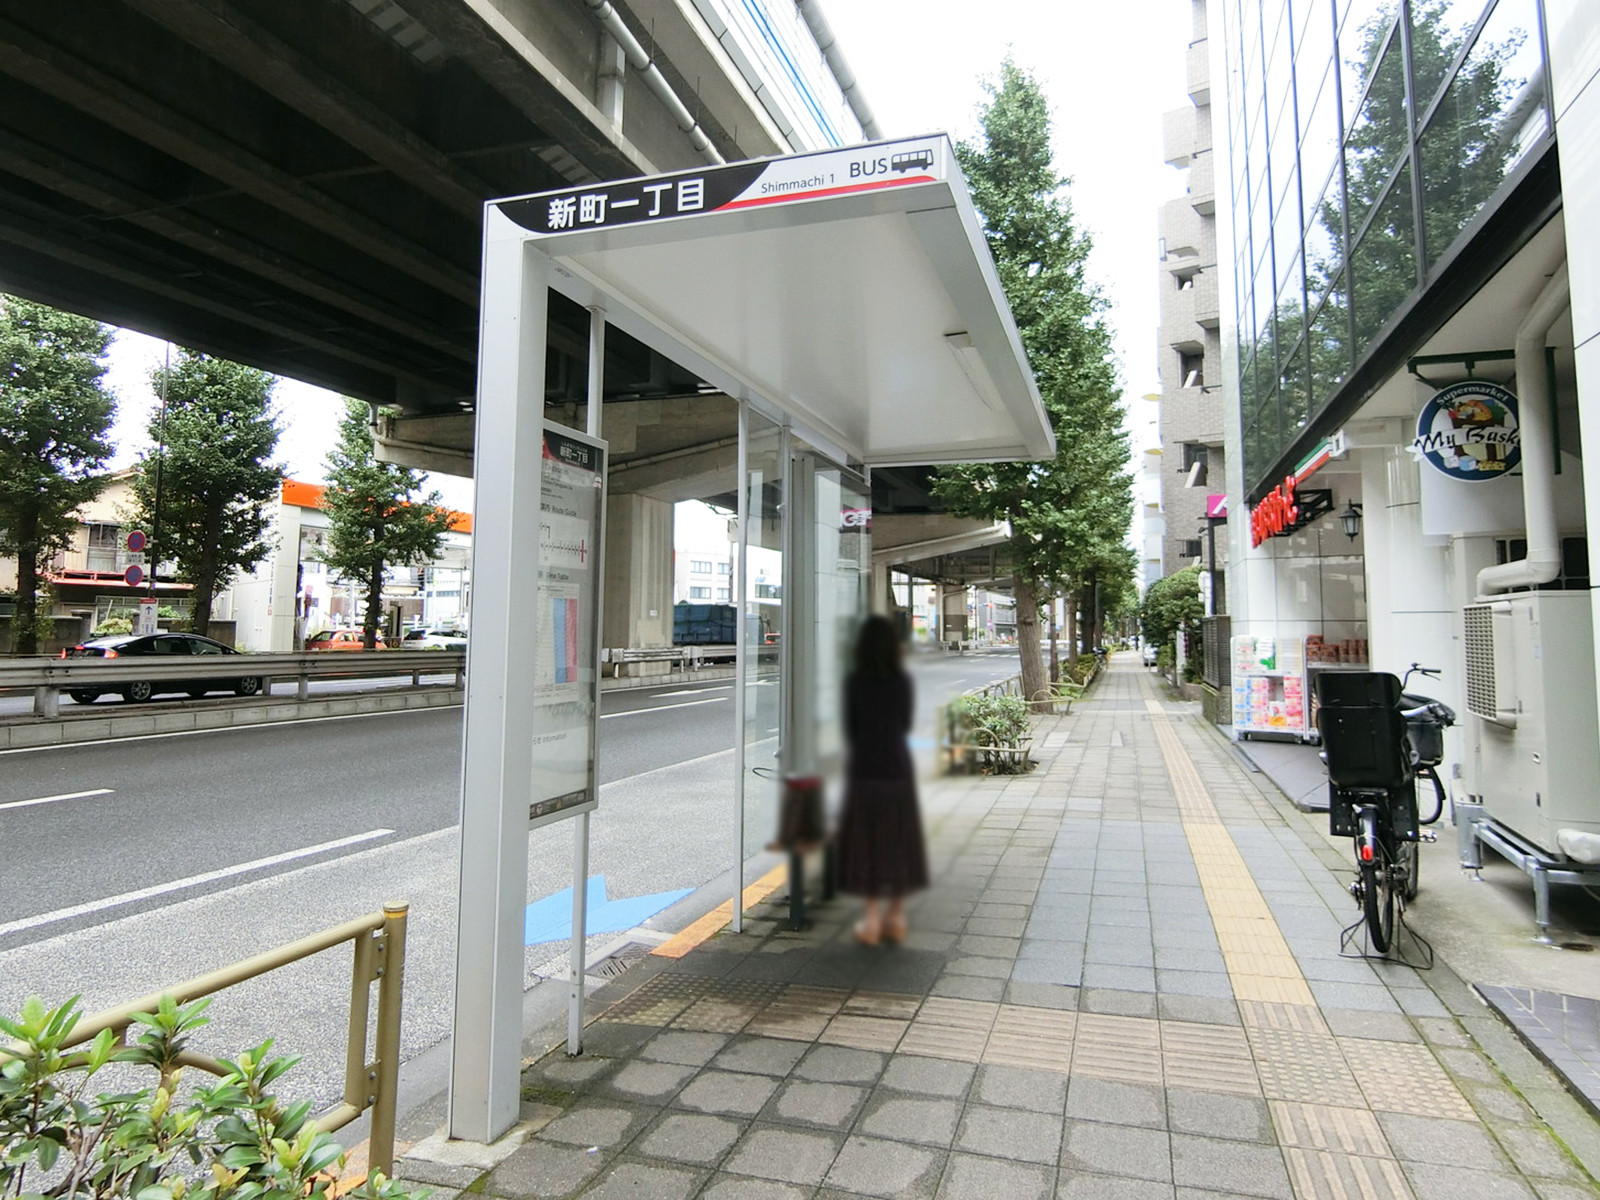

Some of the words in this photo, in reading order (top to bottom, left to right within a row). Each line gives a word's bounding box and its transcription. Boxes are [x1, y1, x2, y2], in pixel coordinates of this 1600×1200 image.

[850, 158, 888, 178] BUS
[761, 175, 825, 194] Shimmachi
[829, 173, 835, 184] 1
[548, 178, 705, 230] 新町一丁目
[1436, 386, 1510, 406] Supermarket
[1414, 431, 1456, 453] My
[1466, 425, 1520, 445] Bask
